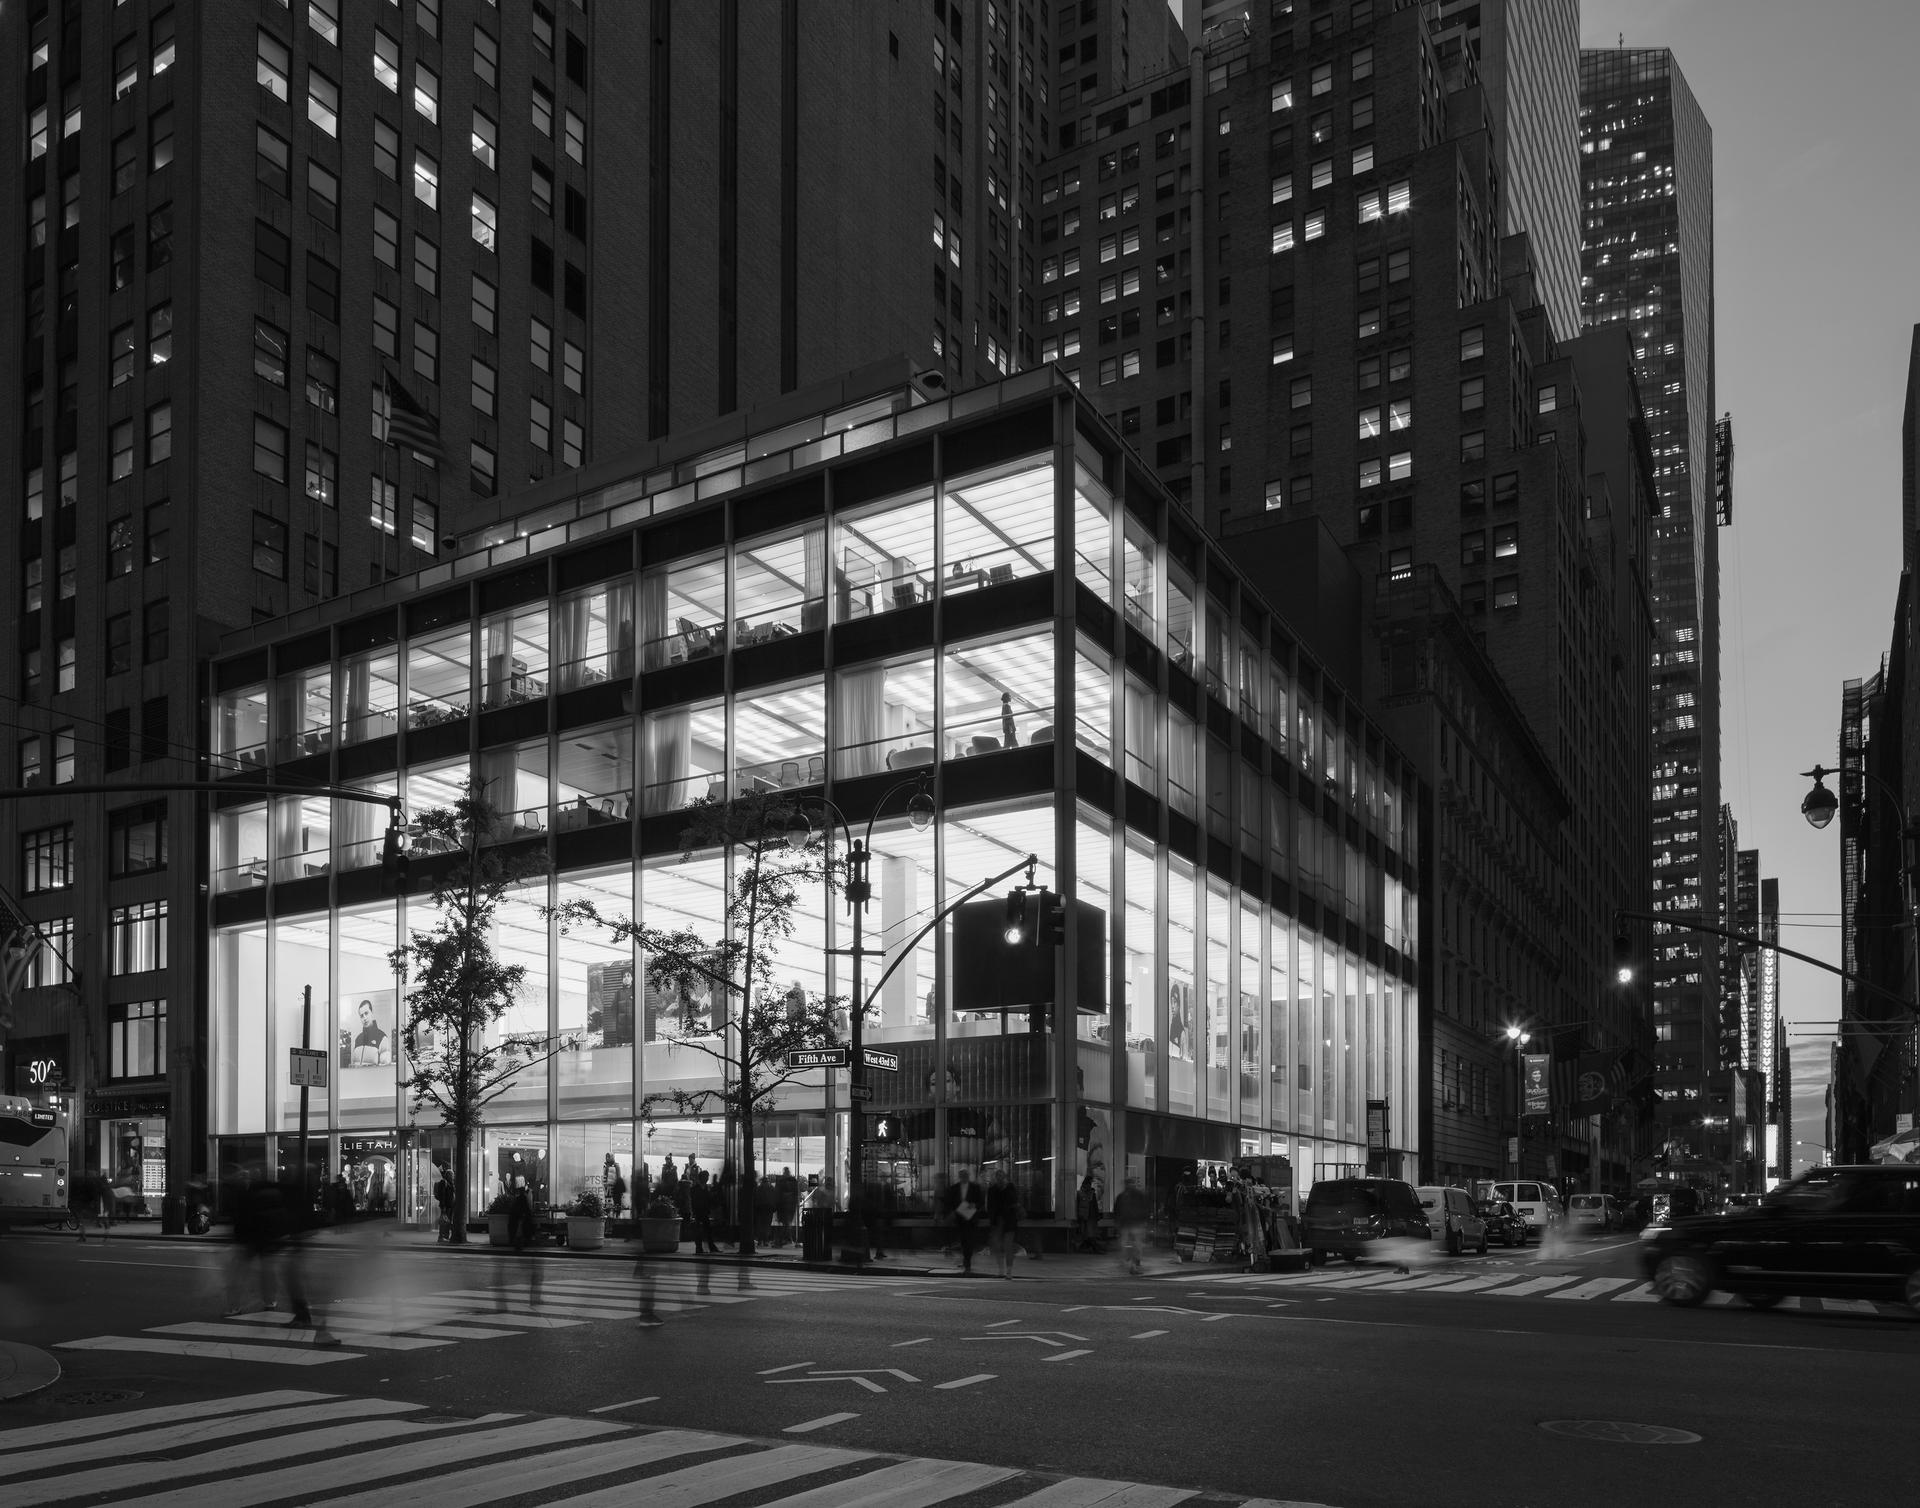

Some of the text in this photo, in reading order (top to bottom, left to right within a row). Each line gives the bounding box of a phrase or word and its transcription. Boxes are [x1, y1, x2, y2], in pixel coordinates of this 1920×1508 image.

[798, 1053, 837, 1064] Fifth Ave
[865, 1053, 896, 1068] West 43rd St
[34, 1113, 54, 1121] LIMITED
